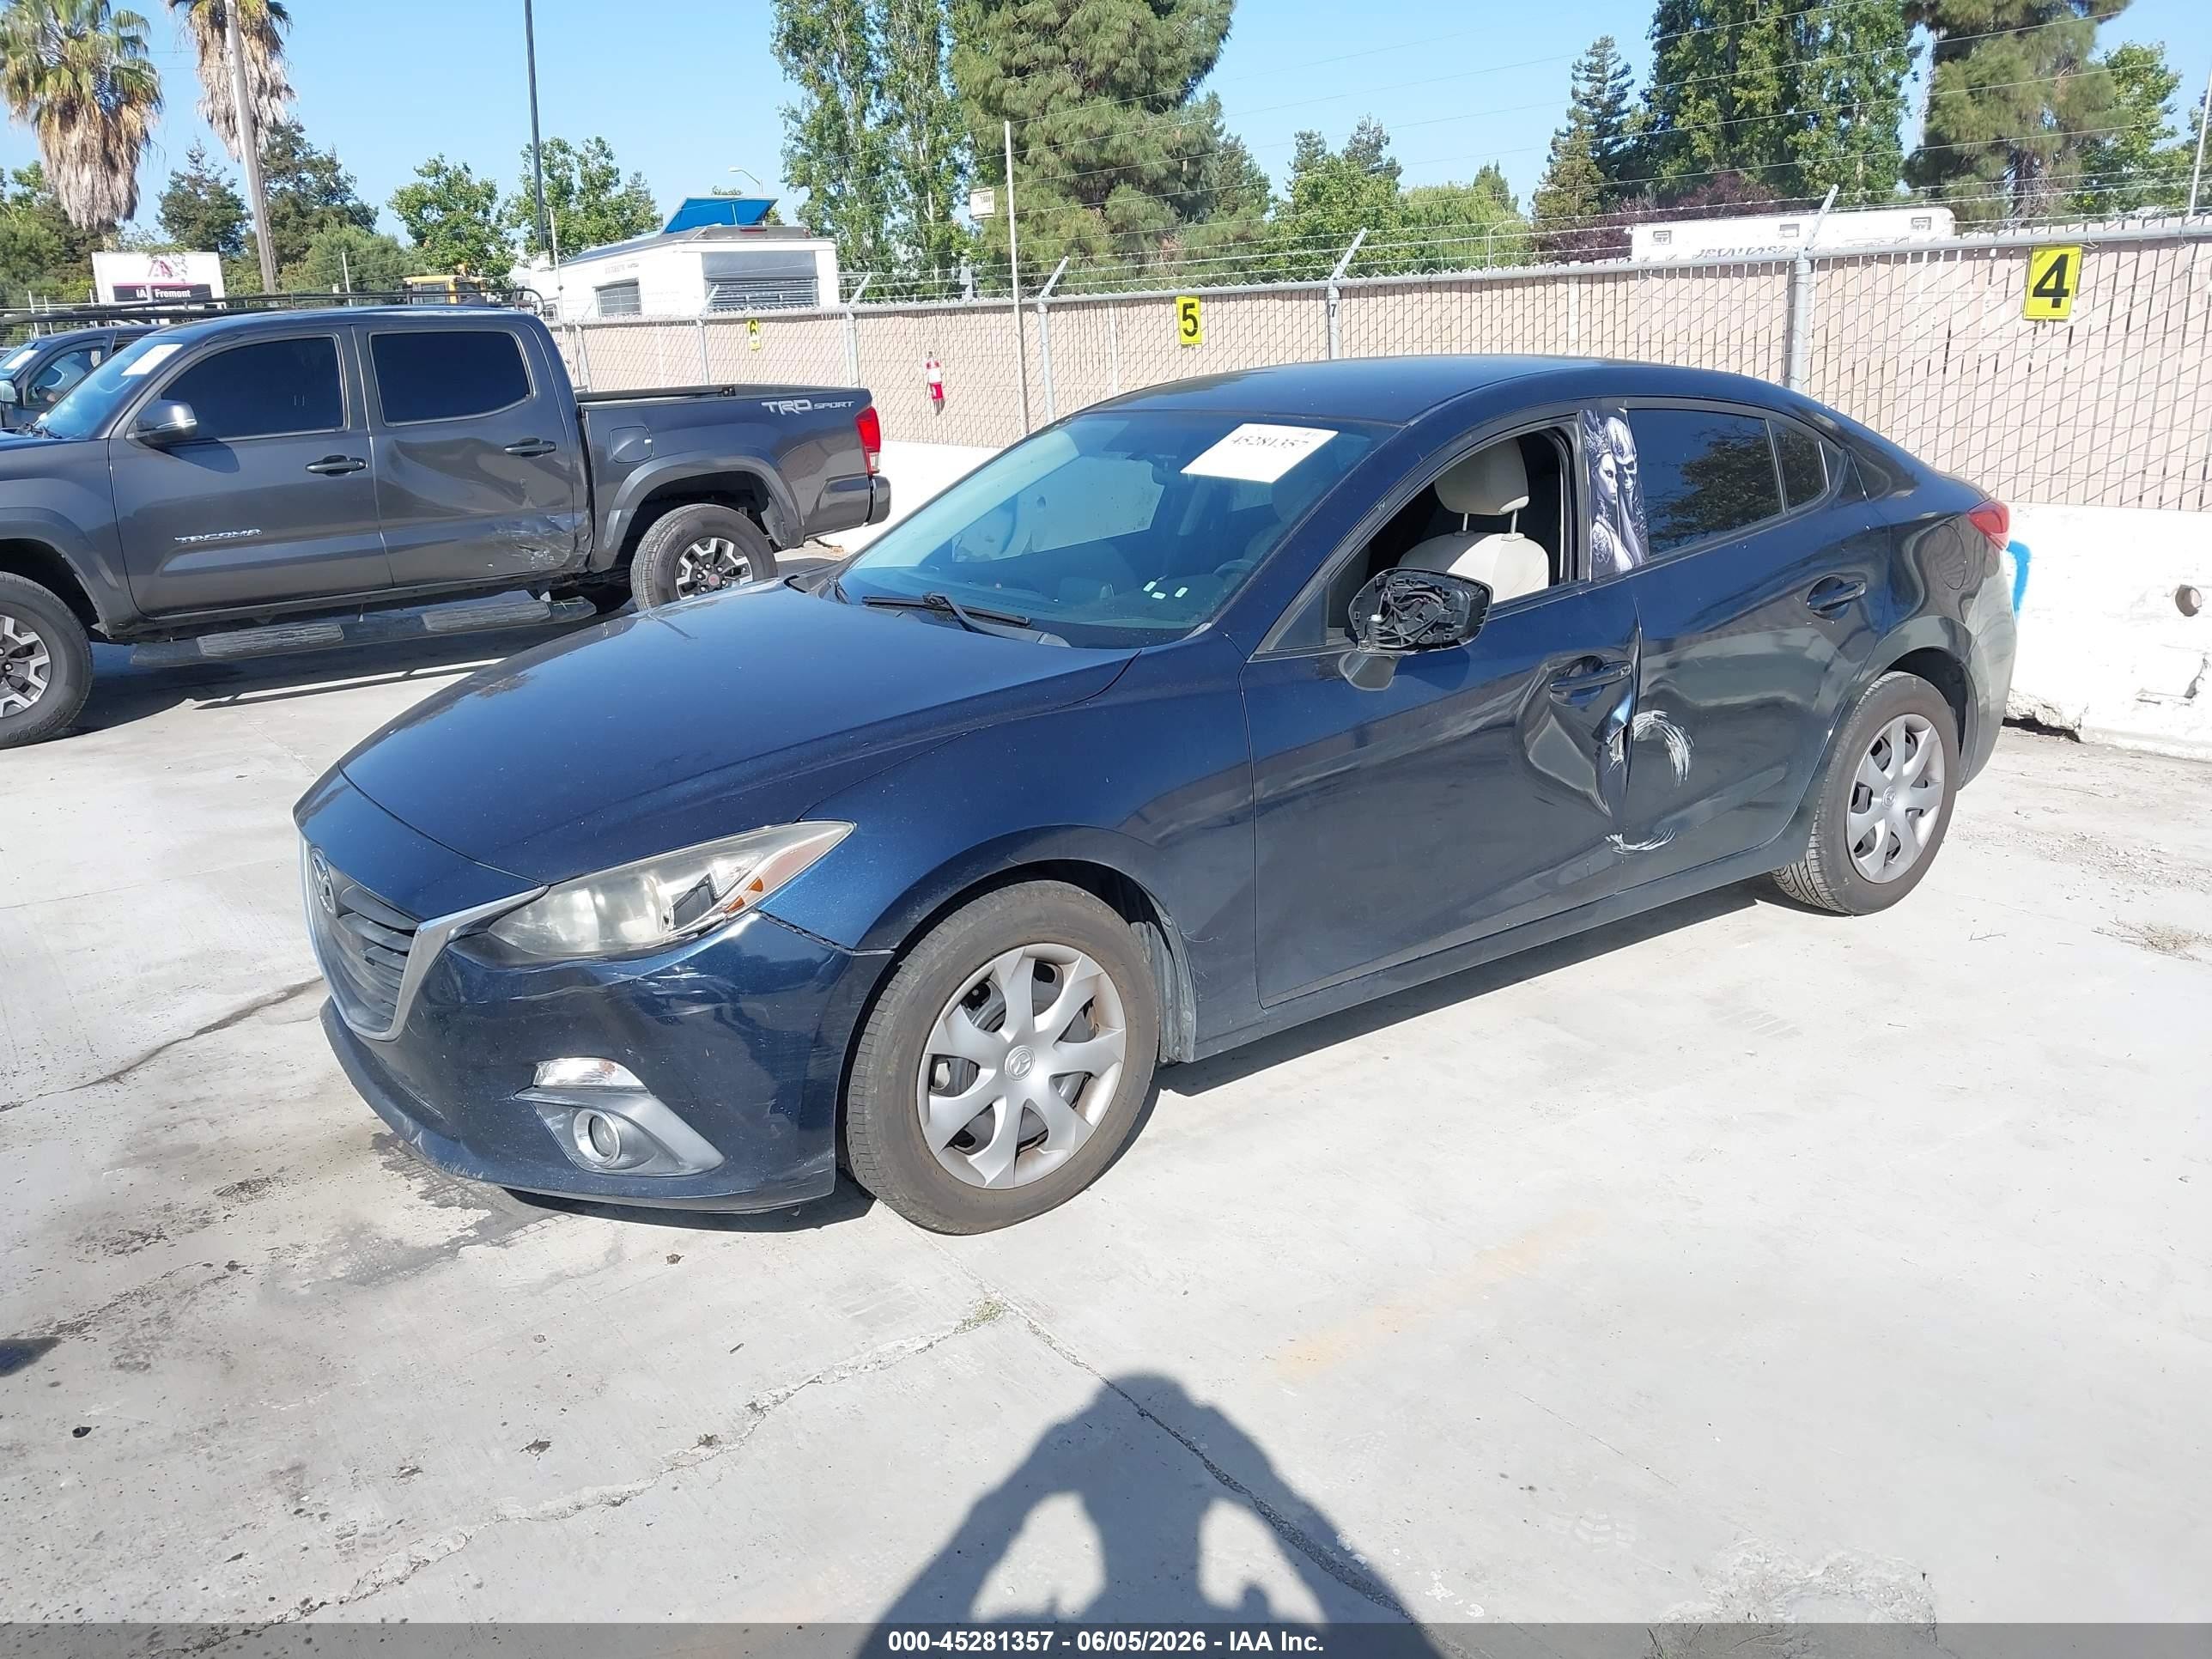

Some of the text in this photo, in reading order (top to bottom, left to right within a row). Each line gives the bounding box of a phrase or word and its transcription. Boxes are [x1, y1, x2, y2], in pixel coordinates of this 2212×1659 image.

[2033, 254, 2069, 308] 4
[155, 289, 191, 298] Fremont
[1182, 302, 1198, 337] 5
[761, 399, 856, 416] TRD SPORT
[174, 529, 262, 544] TACOMA
